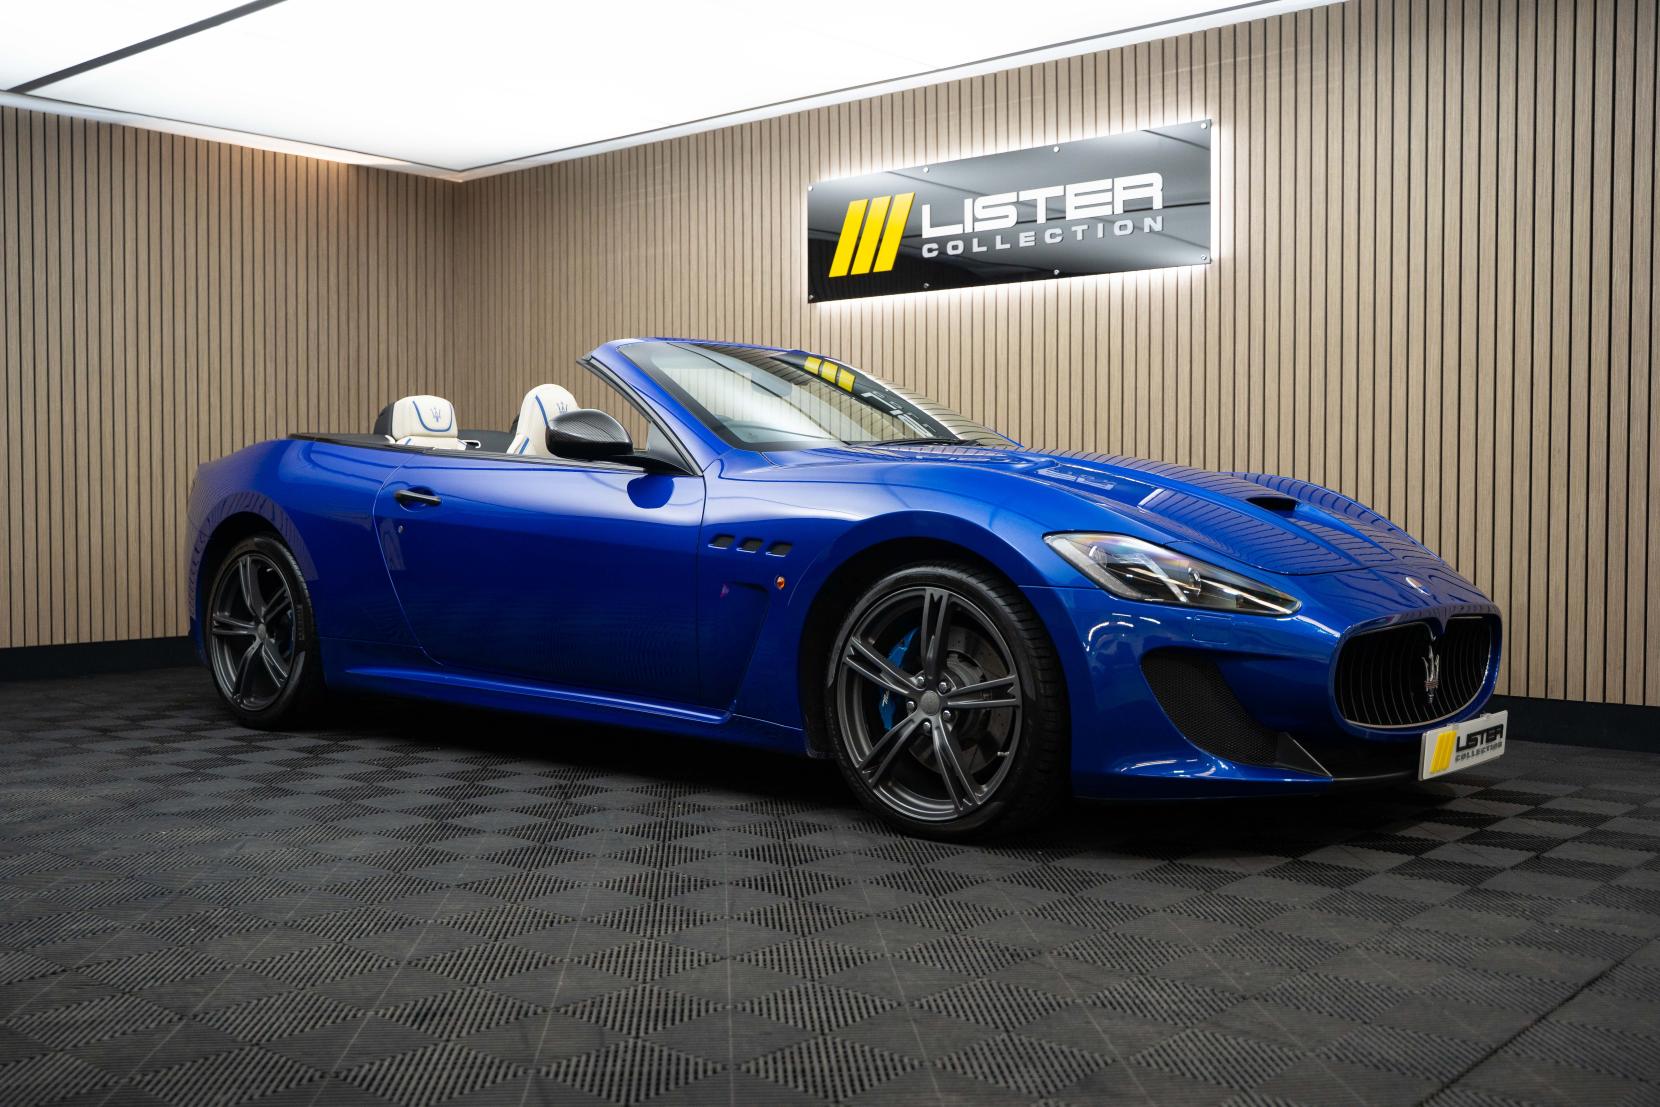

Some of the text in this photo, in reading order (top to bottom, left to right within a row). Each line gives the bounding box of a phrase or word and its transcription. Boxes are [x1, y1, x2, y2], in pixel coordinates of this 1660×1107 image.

[921, 172, 1163, 239] LISTER
[921, 215, 1164, 258] COLLECTION
[1456, 724, 1504, 752] LISTER
